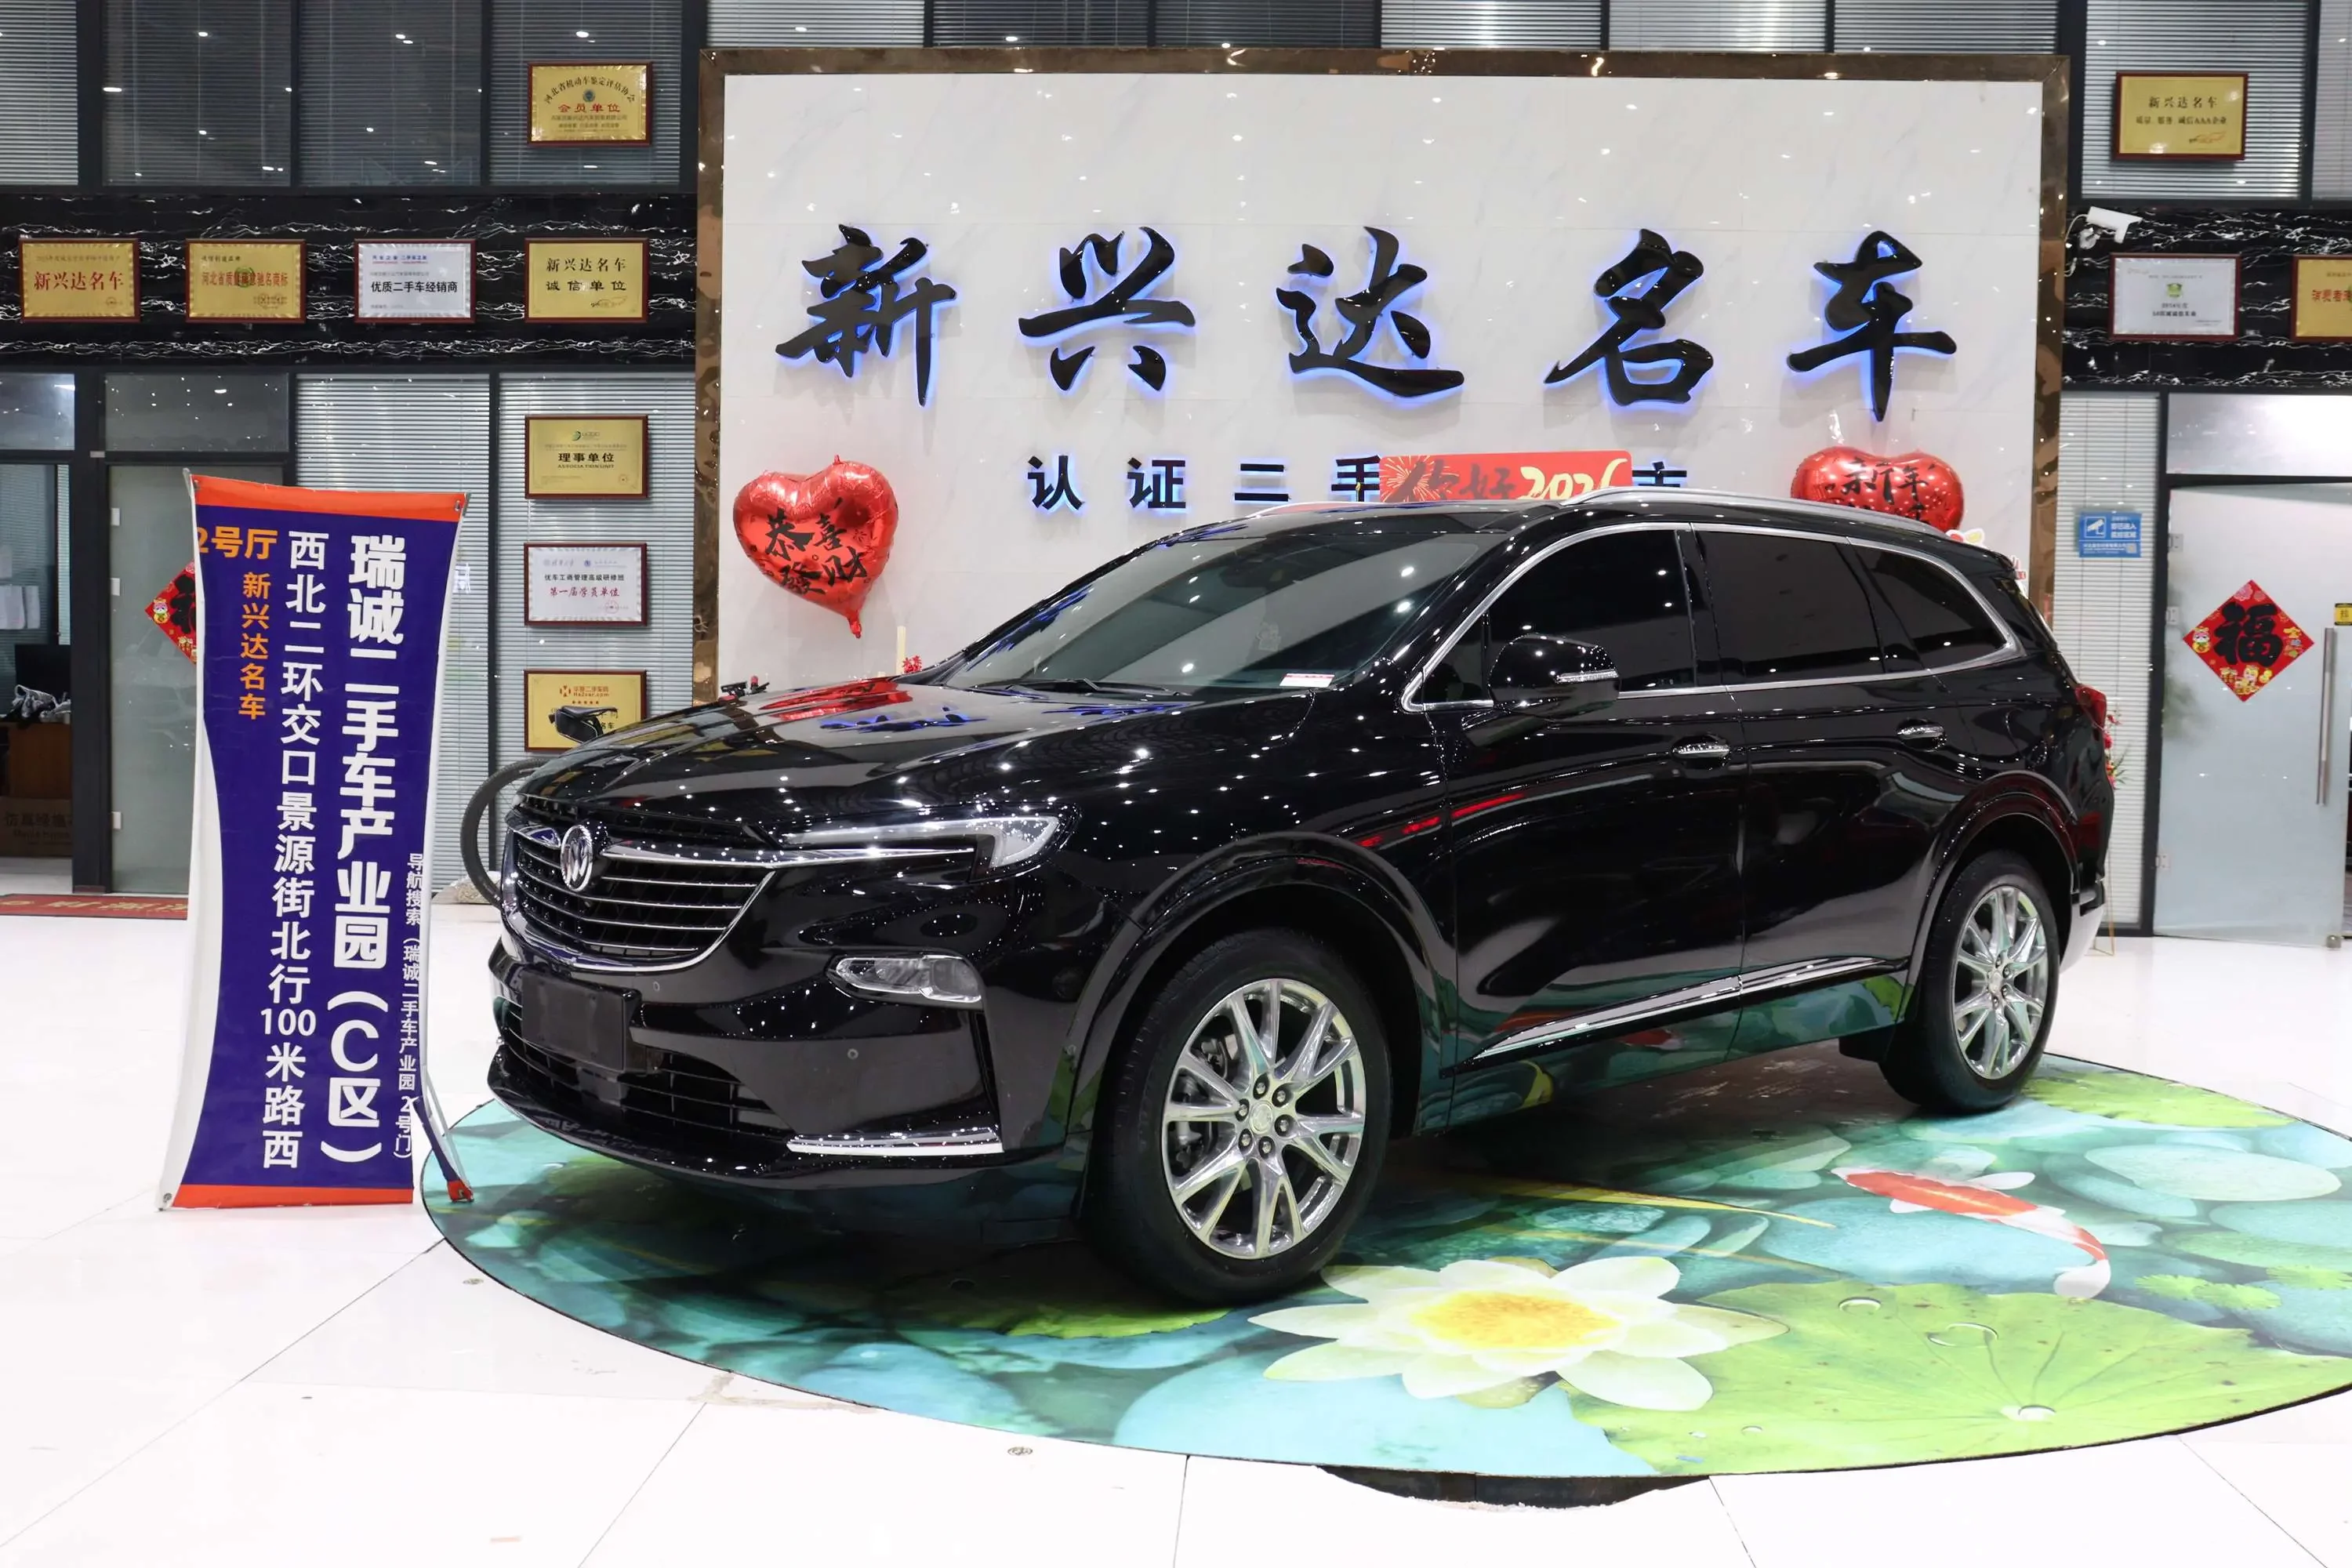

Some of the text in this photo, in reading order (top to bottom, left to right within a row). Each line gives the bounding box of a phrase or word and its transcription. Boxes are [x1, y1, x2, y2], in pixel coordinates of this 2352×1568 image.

[558, 103, 621, 113] 会员单位
[2148, 96, 2218, 109] 新兴达名车
[546, 257, 626, 272] 新兴达名车
[34, 270, 125, 291] 新兴达名车
[371, 281, 458, 293] 优质二手车经销商
[546, 280, 627, 292] 诚信单位
[775, 223, 1958, 422] 新兴达名车
[557, 452, 615, 463] 理事单位
[550, 587, 620, 597] 第一届学员单位
[2213, 601, 2284, 666] 福
[238, 572, 271, 720] 新兴达名车
